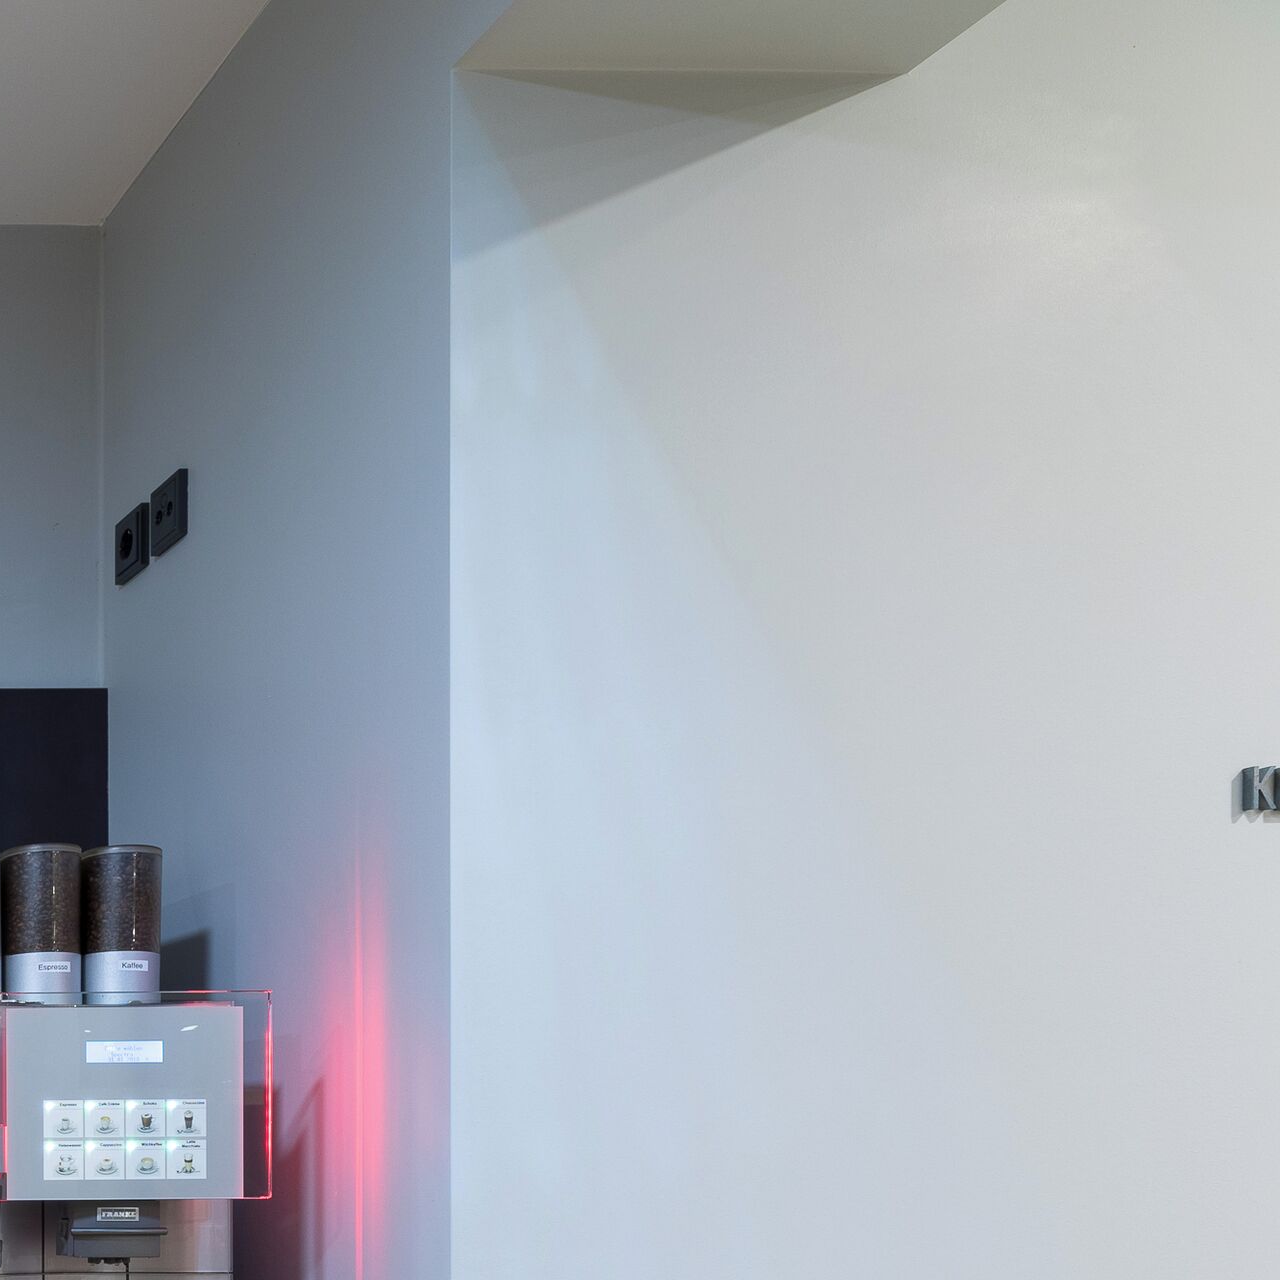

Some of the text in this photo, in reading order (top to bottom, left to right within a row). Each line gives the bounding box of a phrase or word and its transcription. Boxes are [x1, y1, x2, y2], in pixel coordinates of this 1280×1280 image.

[1241, 765, 1280, 811] K
[38, 963, 69, 972] Espresso
[121, 961, 144, 969] Kaffee
